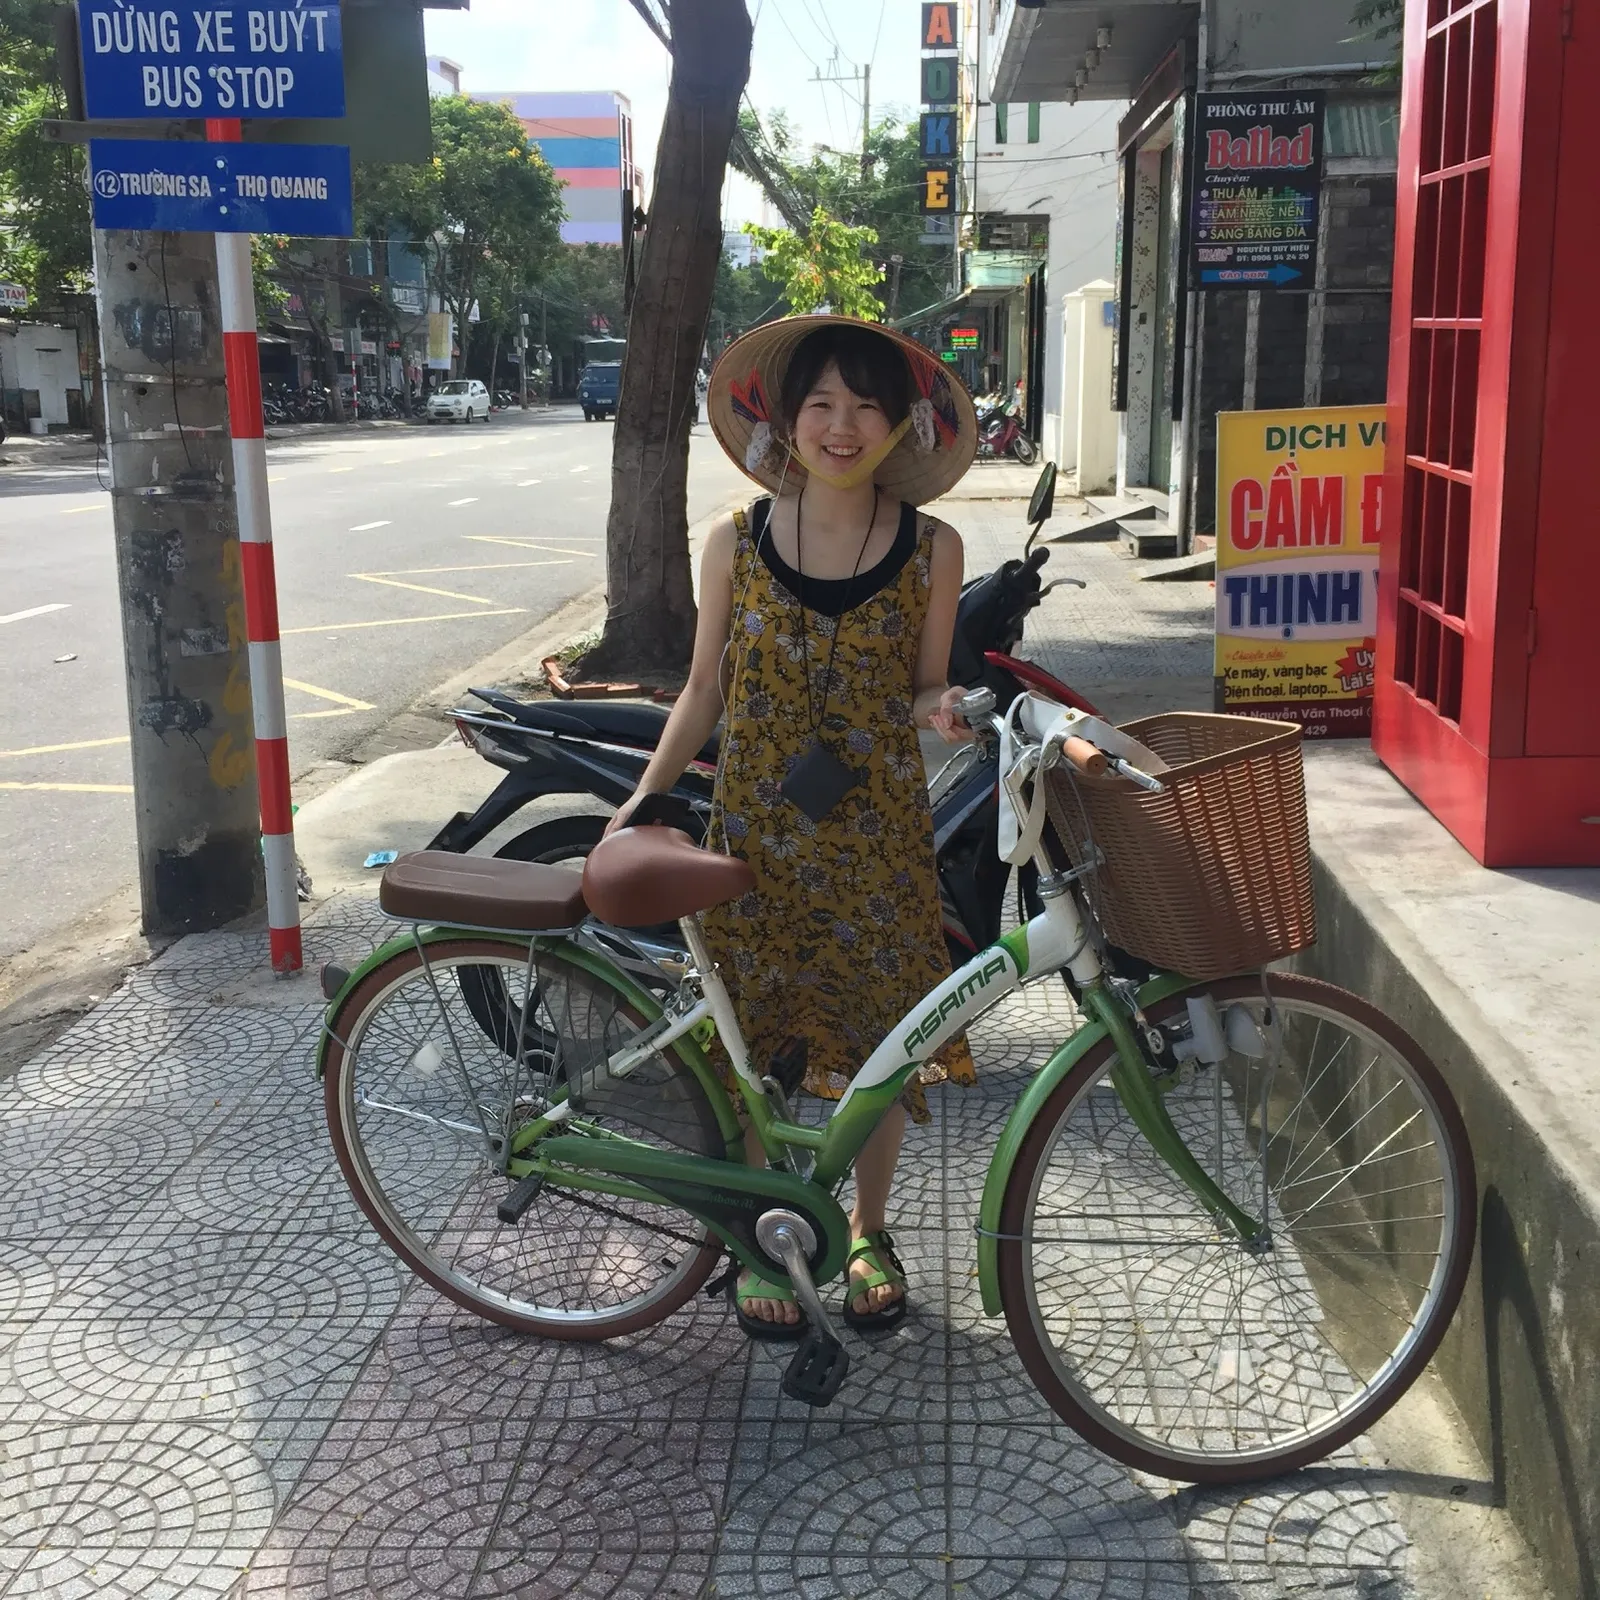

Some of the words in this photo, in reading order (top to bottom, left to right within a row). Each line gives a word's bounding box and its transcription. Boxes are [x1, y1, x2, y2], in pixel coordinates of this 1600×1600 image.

[92, 0, 180, 53] DỪNG
[193, 11, 235, 53] XE
[142, 66, 202, 108] BUS
[217, 66, 293, 109] STOP
[1206, 102, 1256, 117] PHÒNG
[1260, 102, 1290, 116] THU
[1292, 99, 1315, 115] ÂM
[1205, 123, 1314, 170] Ballad
[97, 173, 118, 195] 12
[188, 175, 211, 197] SA
[236, 174, 267, 201] THỌ
[1212, 187, 1234, 198] THU
[1266, 424, 1346, 457] DỊCH
[1230, 462, 1343, 550] CẦM
[1225, 571, 1361, 640] THỊNH
[1223, 667, 1239, 680] Xe
[1241, 665, 1270, 681] máy,
[1273, 664, 1303, 680] vàng
[1305, 663, 1328, 678] bạc
[1252, 683, 1286, 698] thoại,
[1289, 683, 1338, 698] laptop...
[1250, 707, 1298, 720] Nguyễn
[1301, 707, 1326, 719] Văn
[1329, 706, 1363, 720] Thoại
[1305, 725, 1328, 736] 429
[903, 955, 1007, 1058] ASAMA
